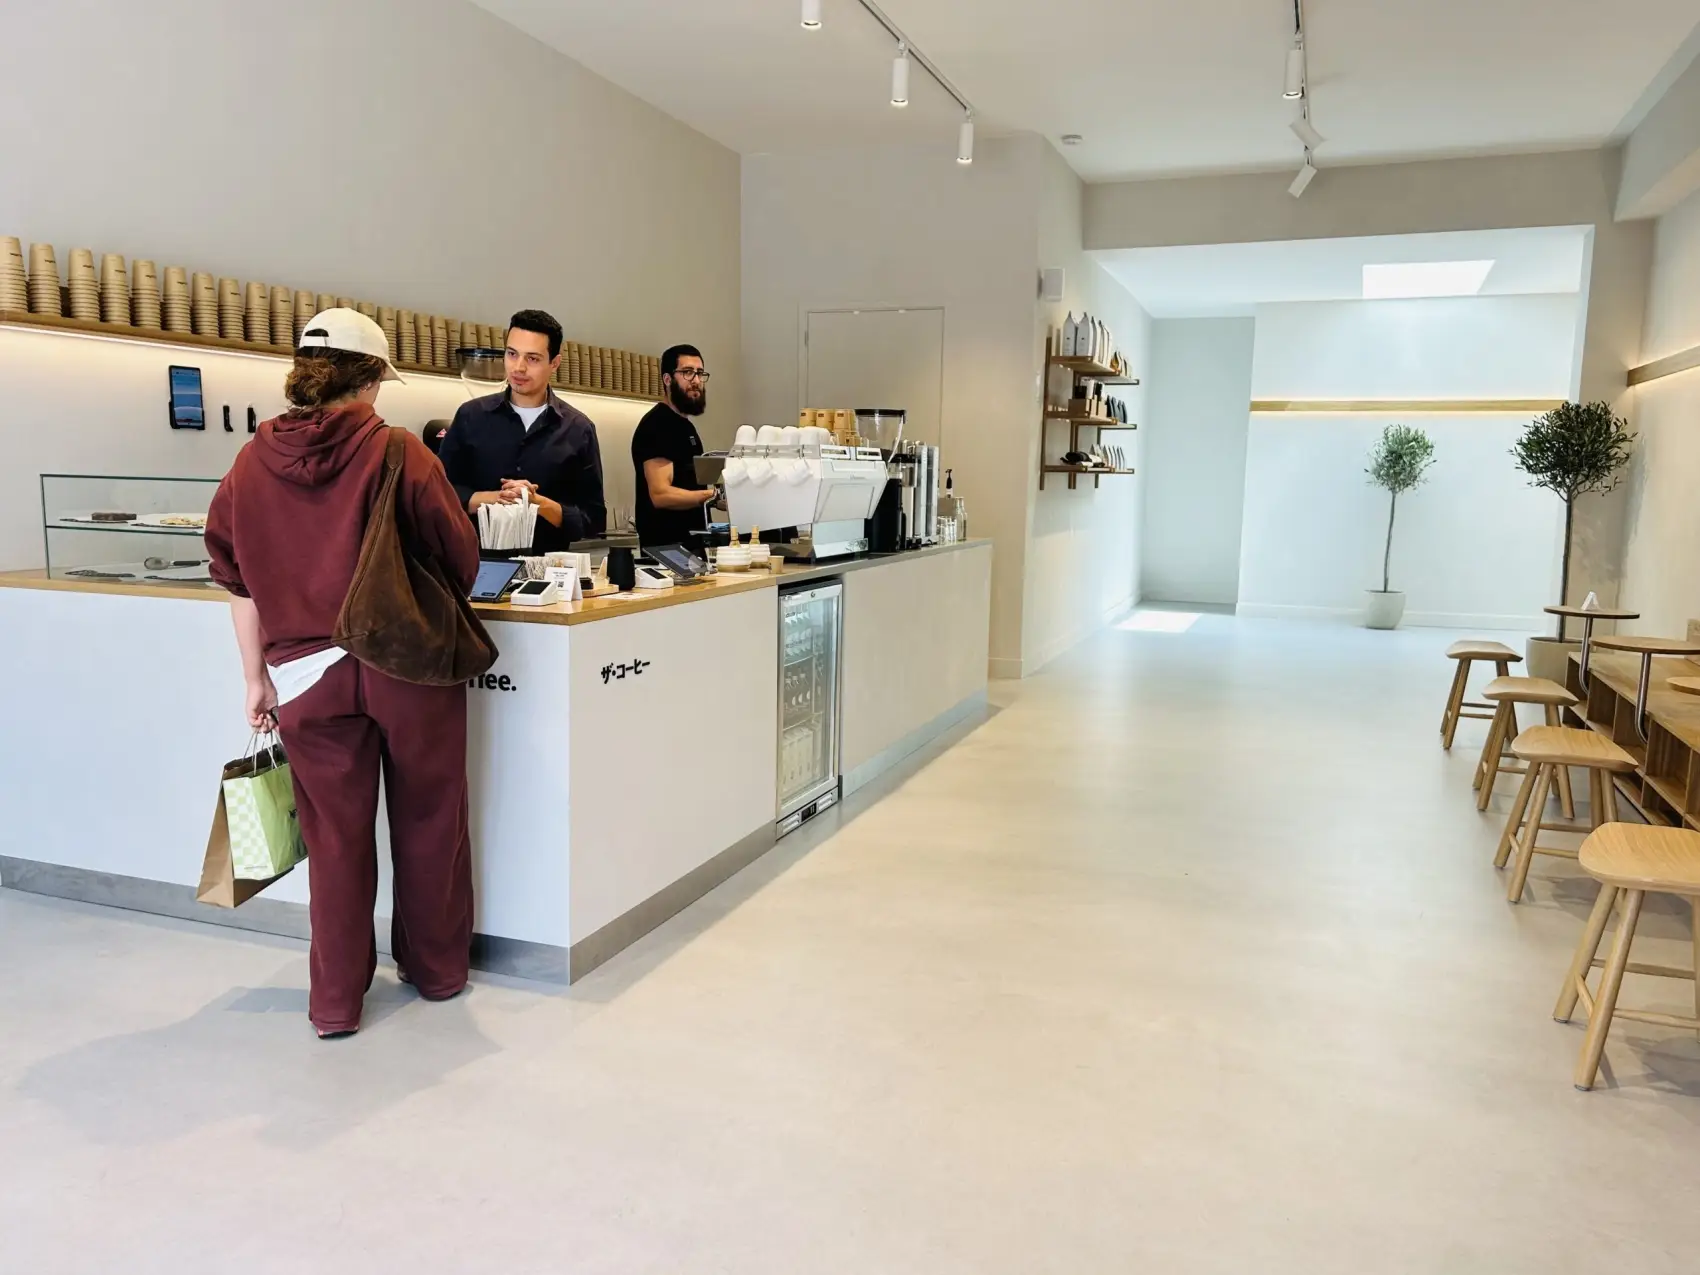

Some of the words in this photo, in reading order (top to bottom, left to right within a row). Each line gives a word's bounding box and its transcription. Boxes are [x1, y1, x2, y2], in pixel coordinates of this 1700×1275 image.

[600, 658, 651, 685] ザ・コーヒー
